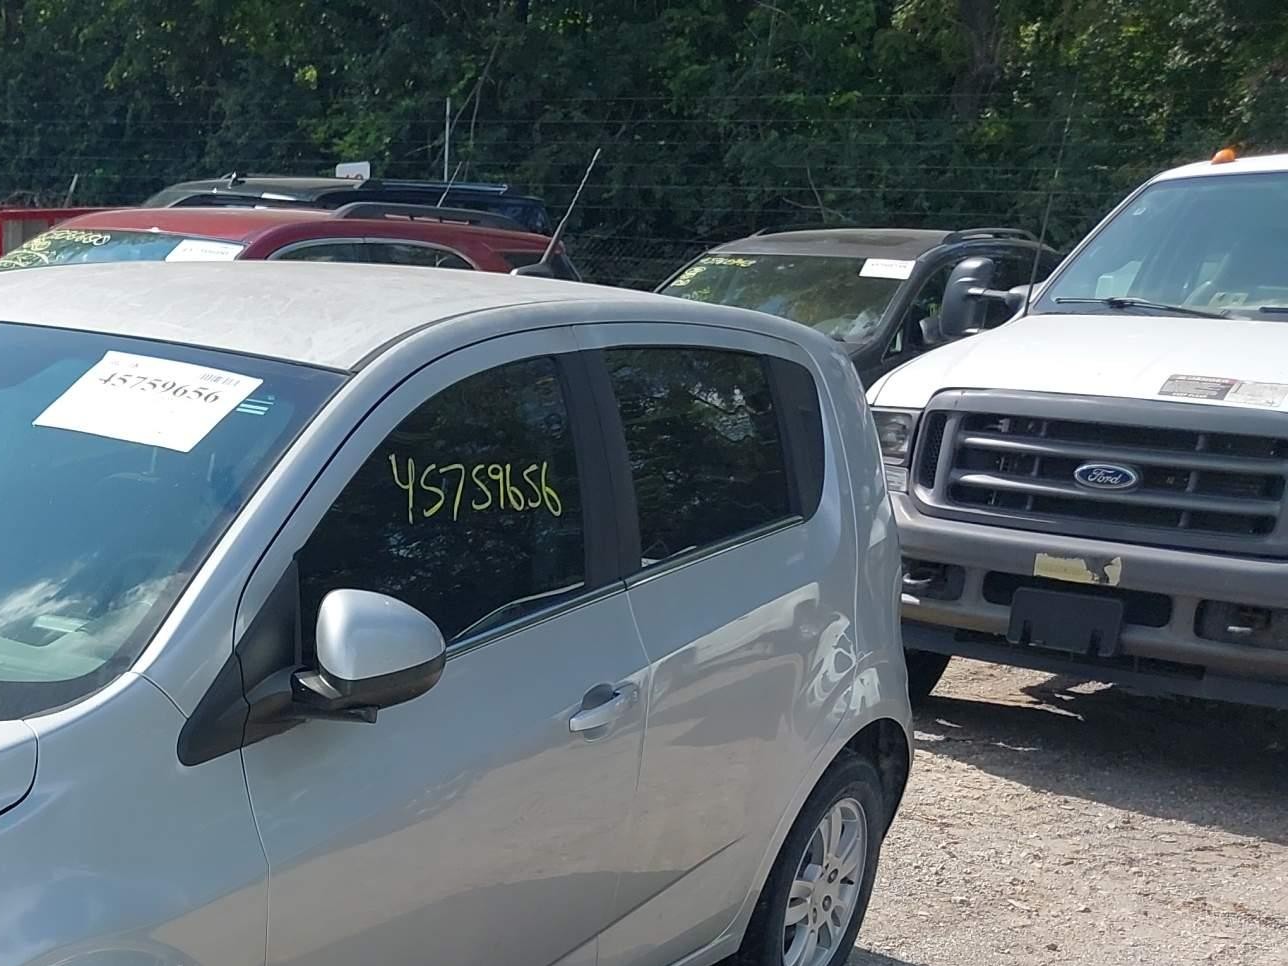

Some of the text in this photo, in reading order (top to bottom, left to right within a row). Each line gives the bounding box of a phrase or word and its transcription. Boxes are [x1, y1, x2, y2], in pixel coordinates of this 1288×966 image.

[99, 371, 223, 404] 45759656
[388, 453, 562, 525] 45759656
[1086, 467, 1124, 485] Ford
